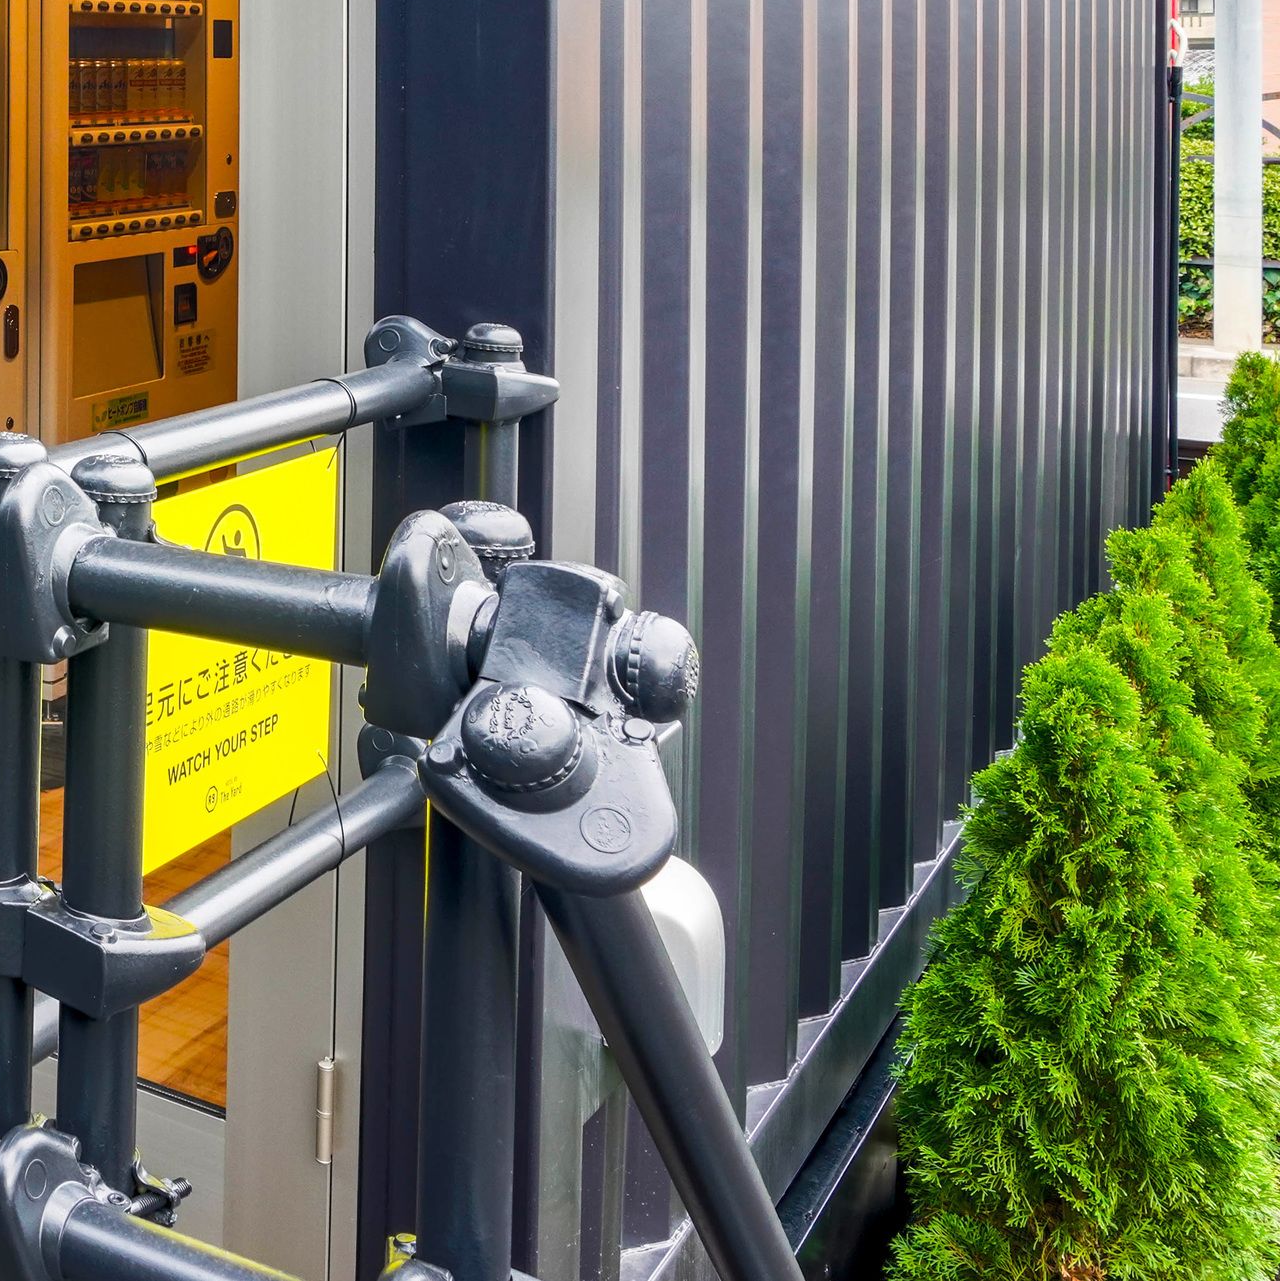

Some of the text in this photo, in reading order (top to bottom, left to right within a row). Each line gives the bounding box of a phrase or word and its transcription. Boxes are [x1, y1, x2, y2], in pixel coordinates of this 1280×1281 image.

[168, 714, 279, 786] WATCH YOUR STEP
